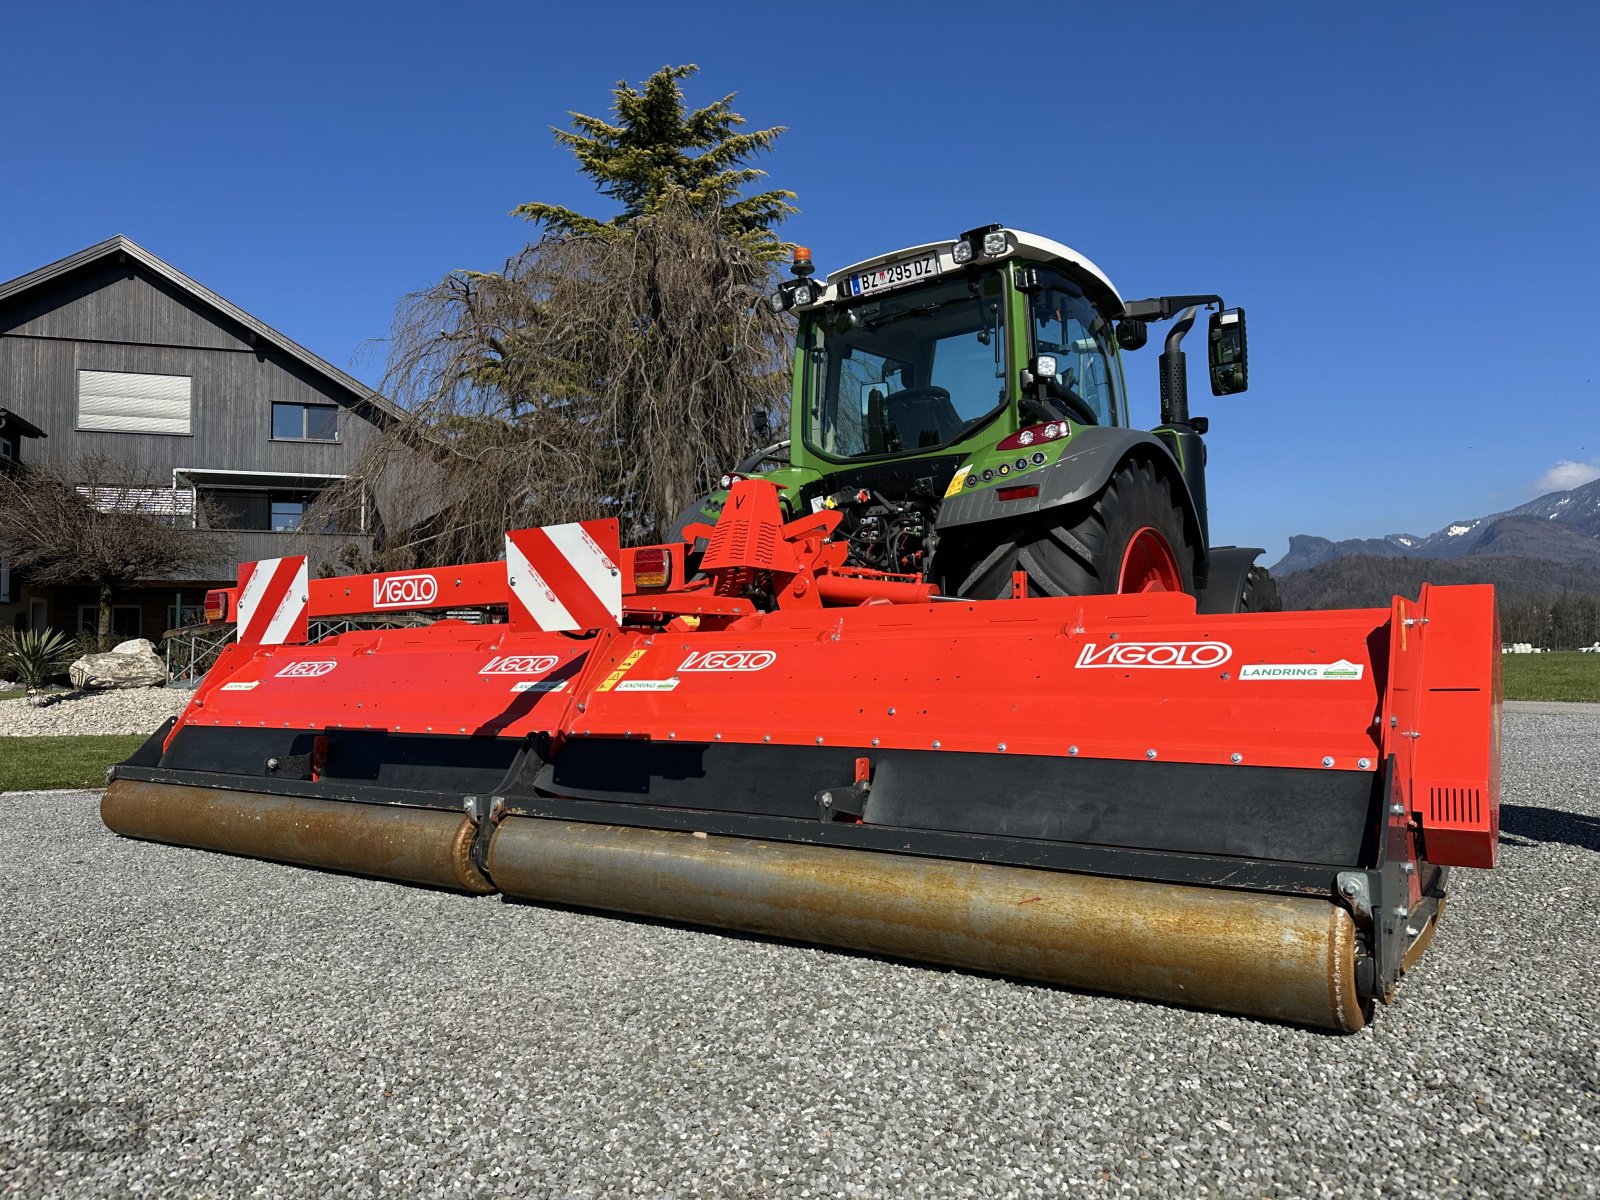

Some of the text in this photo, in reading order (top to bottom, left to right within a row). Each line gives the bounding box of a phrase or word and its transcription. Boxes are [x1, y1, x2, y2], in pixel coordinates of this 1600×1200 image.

[861, 273, 878, 290] BZ
[887, 263, 912, 284] 295
[914, 258, 931, 276] DZ
[373, 574, 438, 608] VIGOLO
[478, 655, 559, 675] VIGOLO
[676, 650, 777, 672] VIGOLO
[1074, 641, 1233, 669] VIGOLO
[1242, 668, 1318, 677] LANDRING
